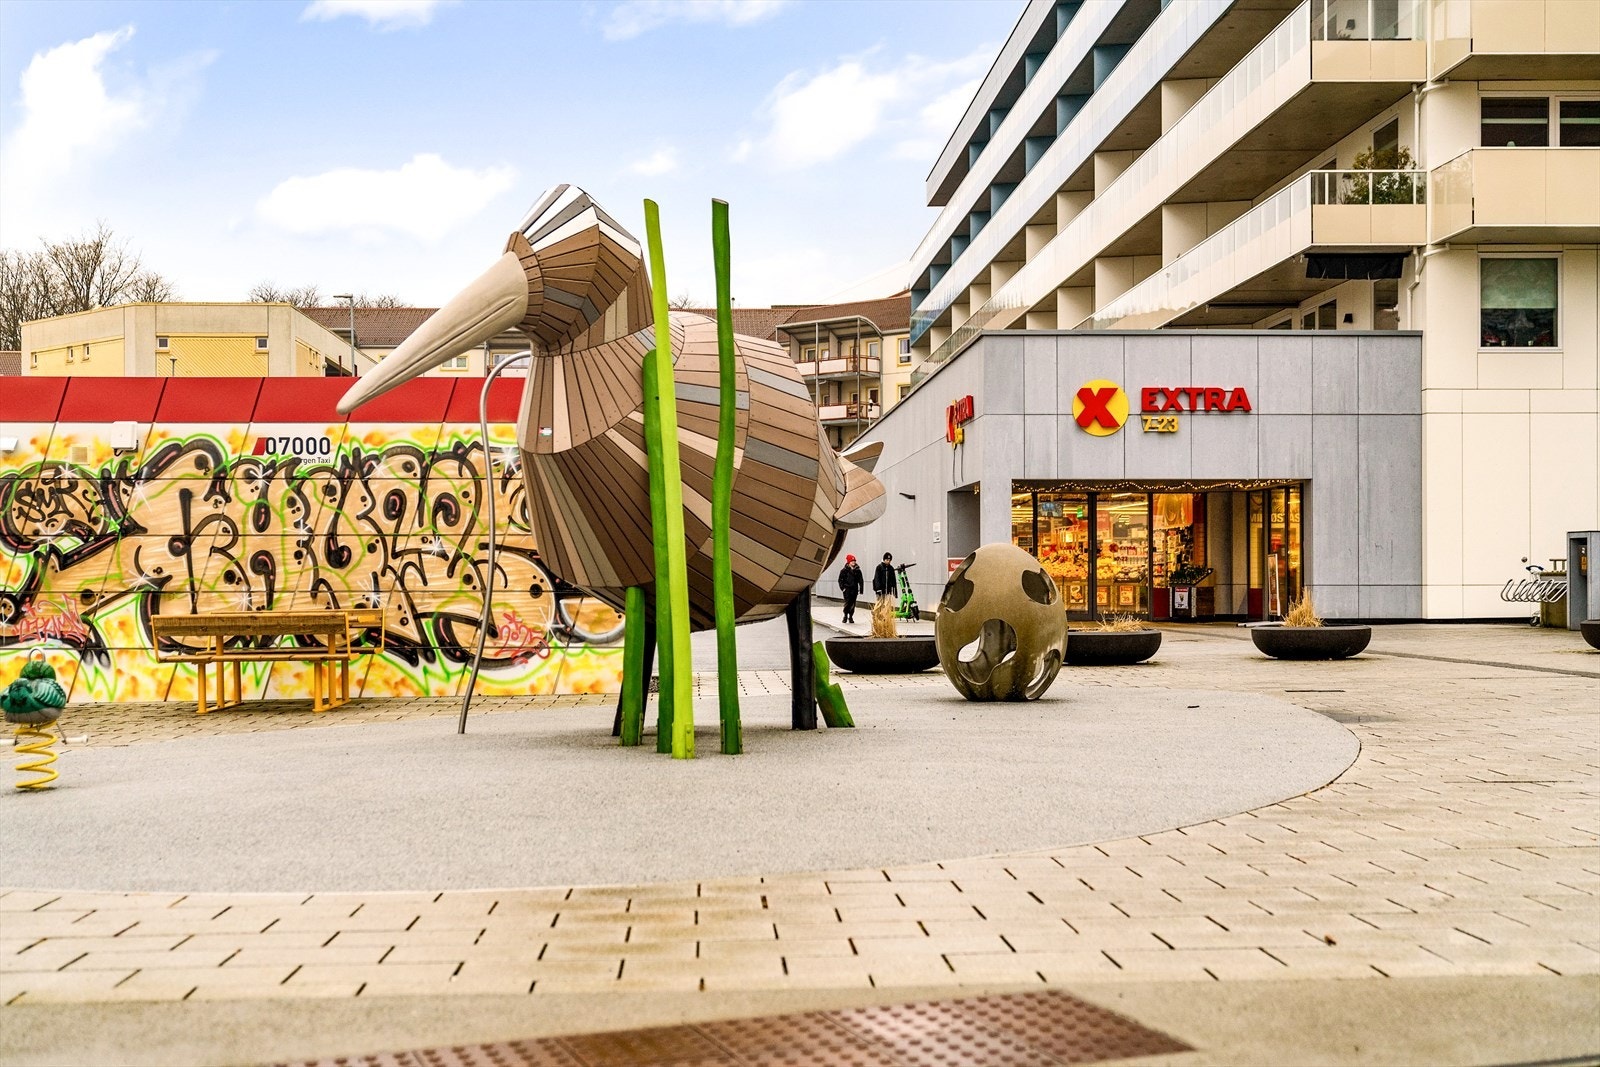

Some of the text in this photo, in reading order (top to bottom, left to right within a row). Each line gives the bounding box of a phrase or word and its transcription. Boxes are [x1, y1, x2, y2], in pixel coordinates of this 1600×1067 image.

[1141, 387, 1252, 412] EXTRA
[1143, 415, 1179, 433] 7-23
[266, 437, 331, 455] 07000
